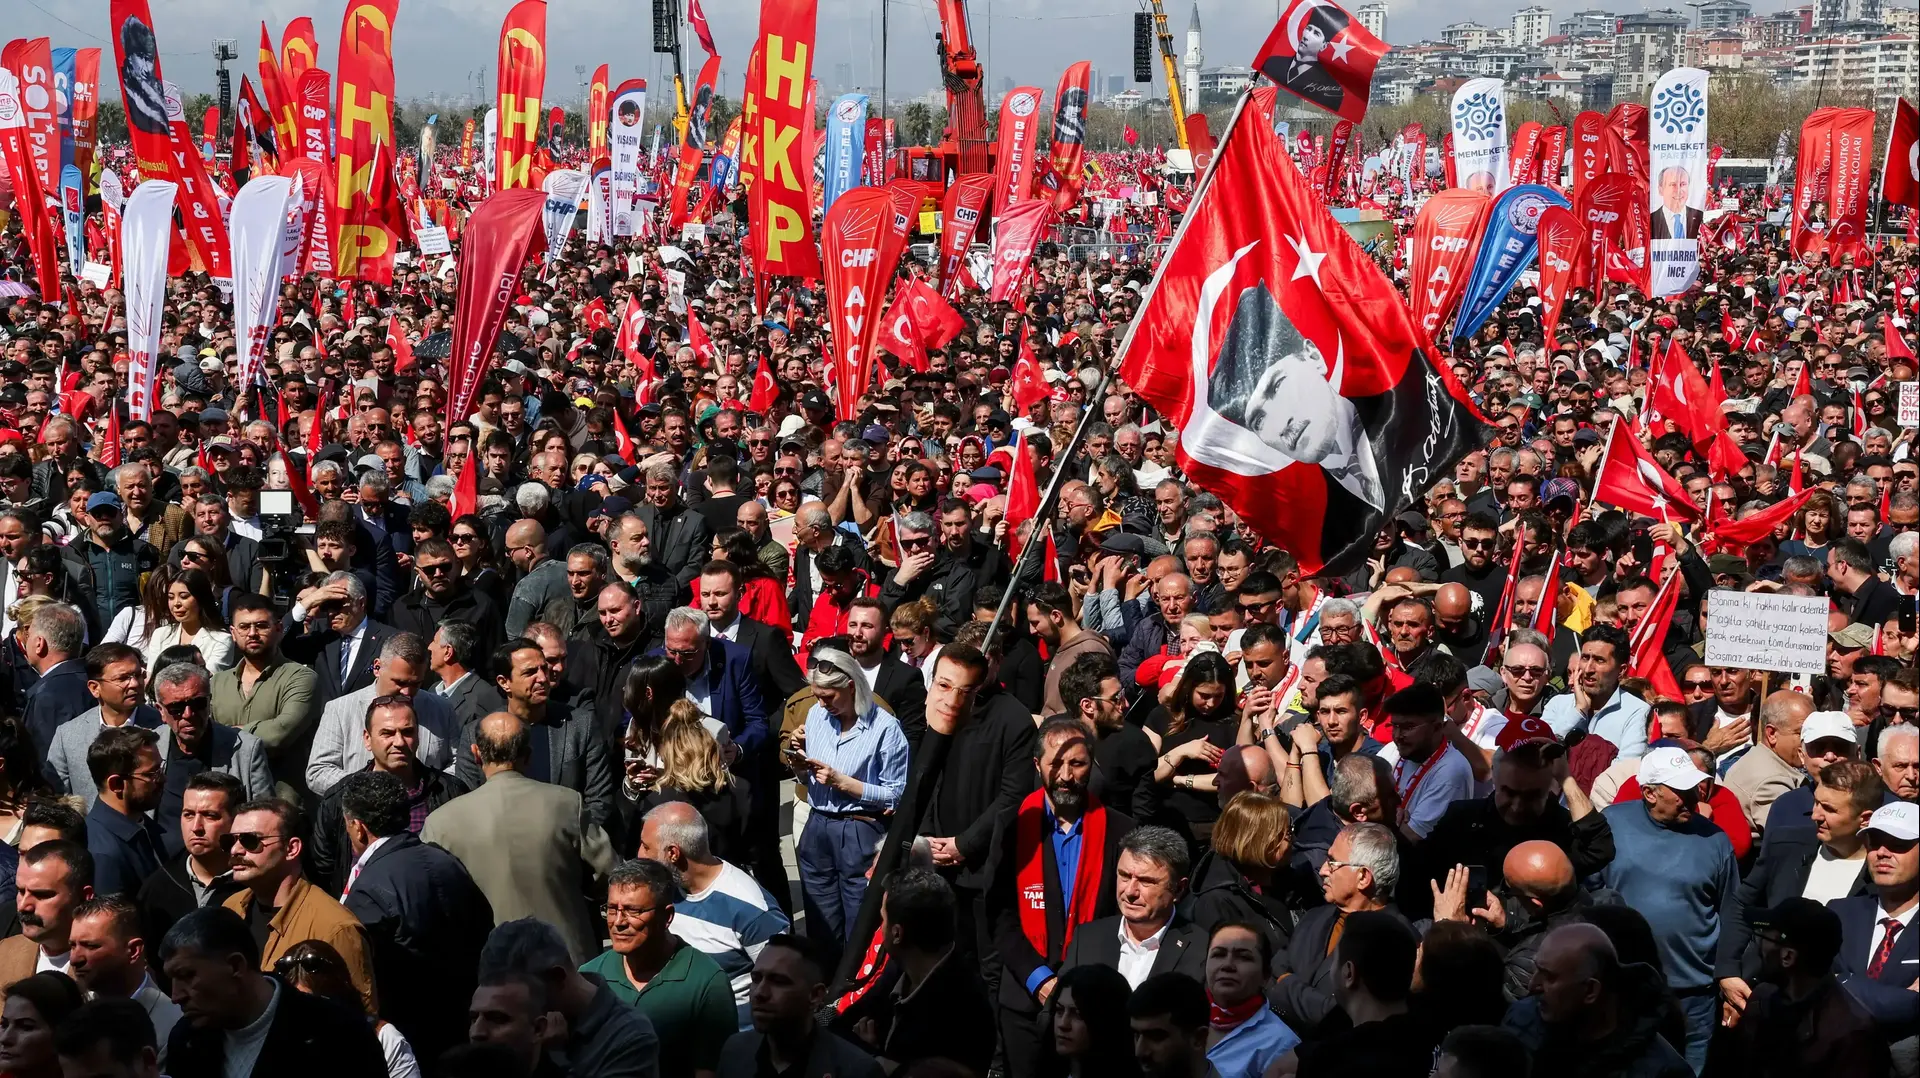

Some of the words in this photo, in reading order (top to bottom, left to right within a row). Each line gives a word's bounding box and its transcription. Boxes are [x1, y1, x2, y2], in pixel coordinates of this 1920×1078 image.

[23, 64, 51, 129] SOL
[74, 82, 92, 95] OL
[303, 104, 326, 123] CHP
[306, 128, 326, 163] AŞA
[502, 93, 540, 190] HK
[764, 33, 808, 262] HKP
[1581, 134, 1599, 142] CHP
[1653, 142, 1705, 151] MEMLEKET
[30, 132, 49, 186] PART
[1008, 121, 1025, 204] BELEDİYE
[1458, 146, 1506, 158] MEMLEKET
[1583, 148, 1596, 180] AVC
[1837, 132, 1850, 195] ARNAVUTKÖY
[1851, 137, 1862, 174] KOLLARI
[338, 82, 390, 278] HKP
[1510, 158, 1523, 186] LTEPE
[1541, 160, 1550, 187] LTEPE
[546, 199, 577, 215] CHP
[1801, 186, 1812, 211] CHP
[1849, 178, 1859, 216] GENÇLİK
[894, 214, 906, 226] HP
[957, 208, 978, 221] CHP
[1588, 209, 1619, 223] CHP
[1430, 235, 1468, 253] CHP
[841, 248, 878, 268] CHP
[1545, 252, 1571, 273] CP
[1667, 265, 1686, 278] İNCE
[1423, 265, 1450, 331] AVC
[1901, 407, 1919, 421] ÖYL
[1708, 590, 1739, 607] Sanma
[1755, 597, 1780, 611] hakkın
[1781, 599, 1799, 613] kalır
[1800, 602, 1828, 615] ademde
[1708, 608, 1742, 628] Kağıtta
[1771, 622, 1797, 634] yazan
[1706, 627, 1727, 641] Bırak
[1784, 636, 1824, 652] duruşmalar
[1794, 658, 1823, 670] alemde
[1023, 891, 1044, 900] TAM
[1031, 899, 1046, 909] İLE
